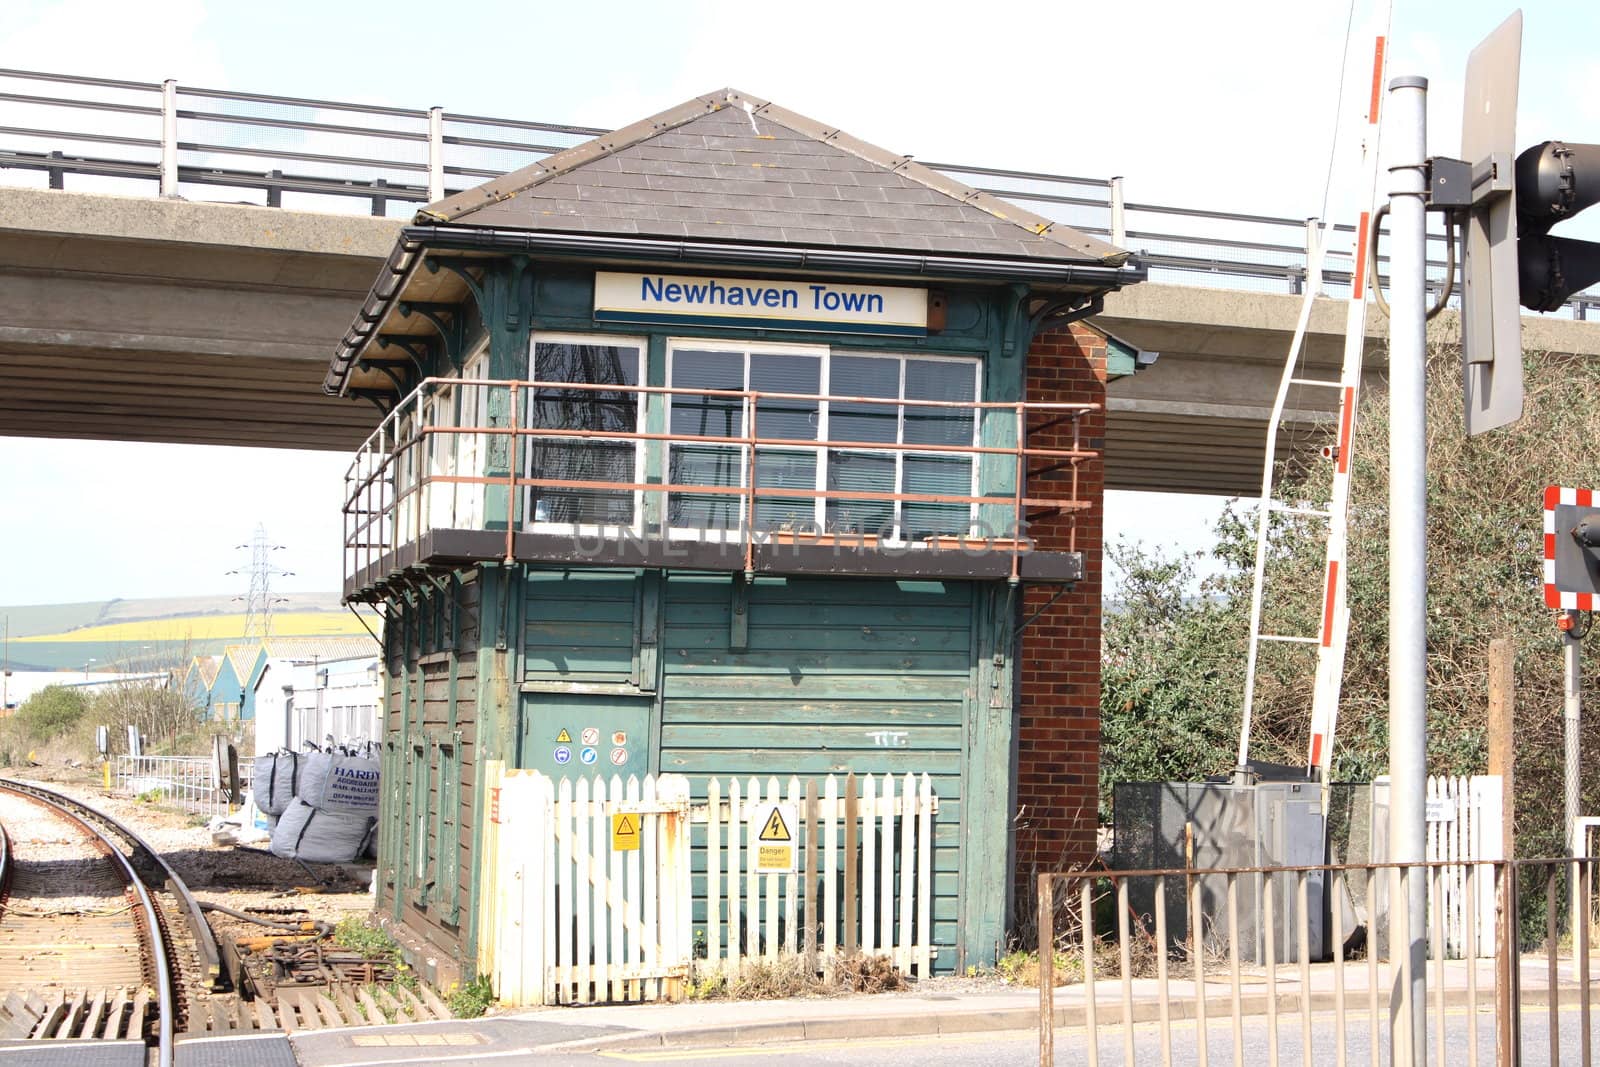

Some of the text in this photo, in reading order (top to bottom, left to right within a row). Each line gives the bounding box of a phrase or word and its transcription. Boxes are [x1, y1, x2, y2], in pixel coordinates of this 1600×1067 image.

[641, 277, 884, 313] Newhaven Town
[760, 846, 785, 856] Danger
